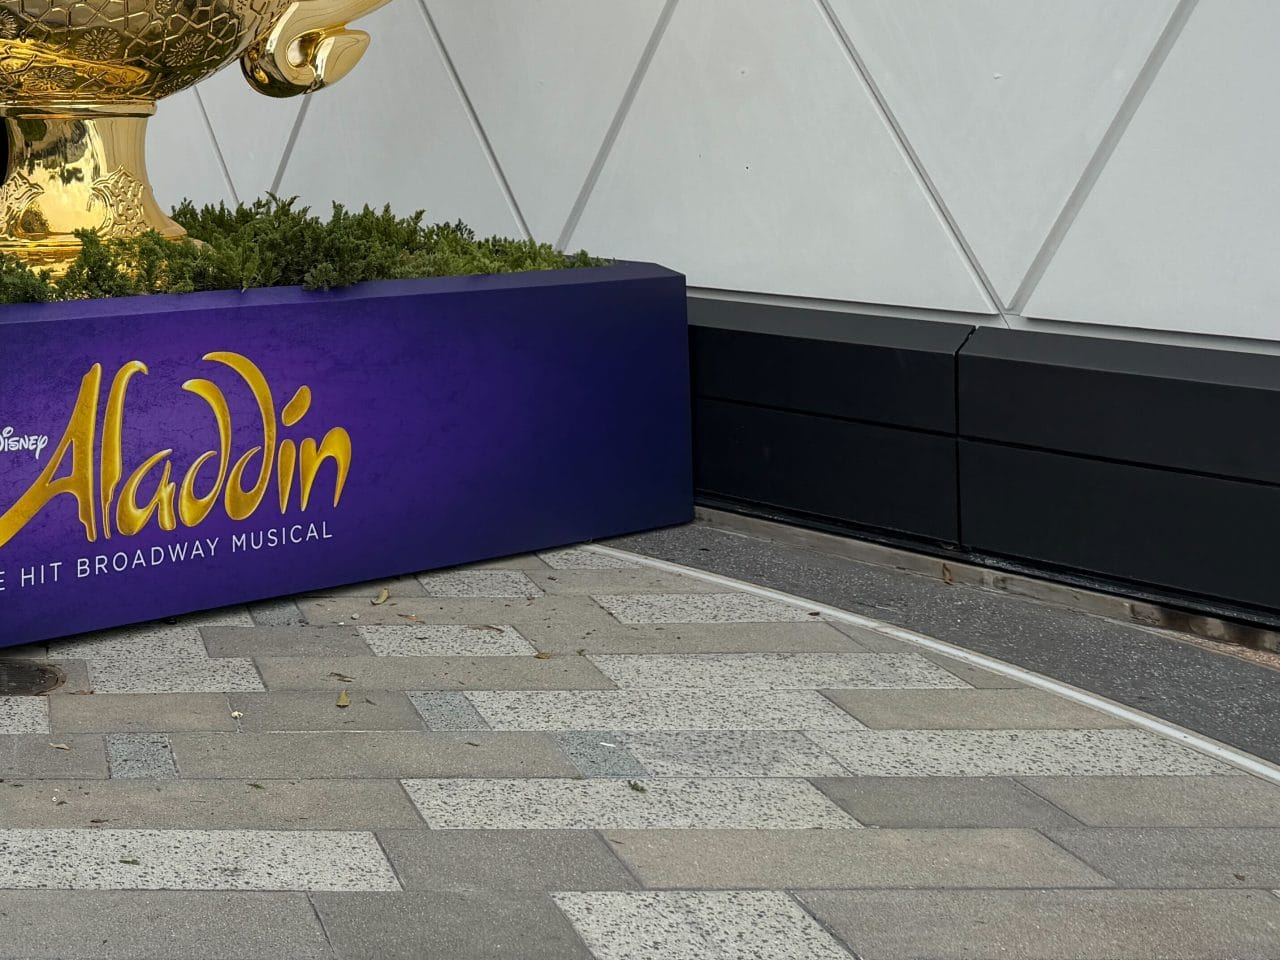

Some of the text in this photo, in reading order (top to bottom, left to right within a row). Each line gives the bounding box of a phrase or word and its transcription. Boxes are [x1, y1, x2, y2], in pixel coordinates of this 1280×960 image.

[20, 562, 62, 587] HIT
[77, 537, 219, 579] BROADWAY
[232, 521, 333, 553] MUSICAL
